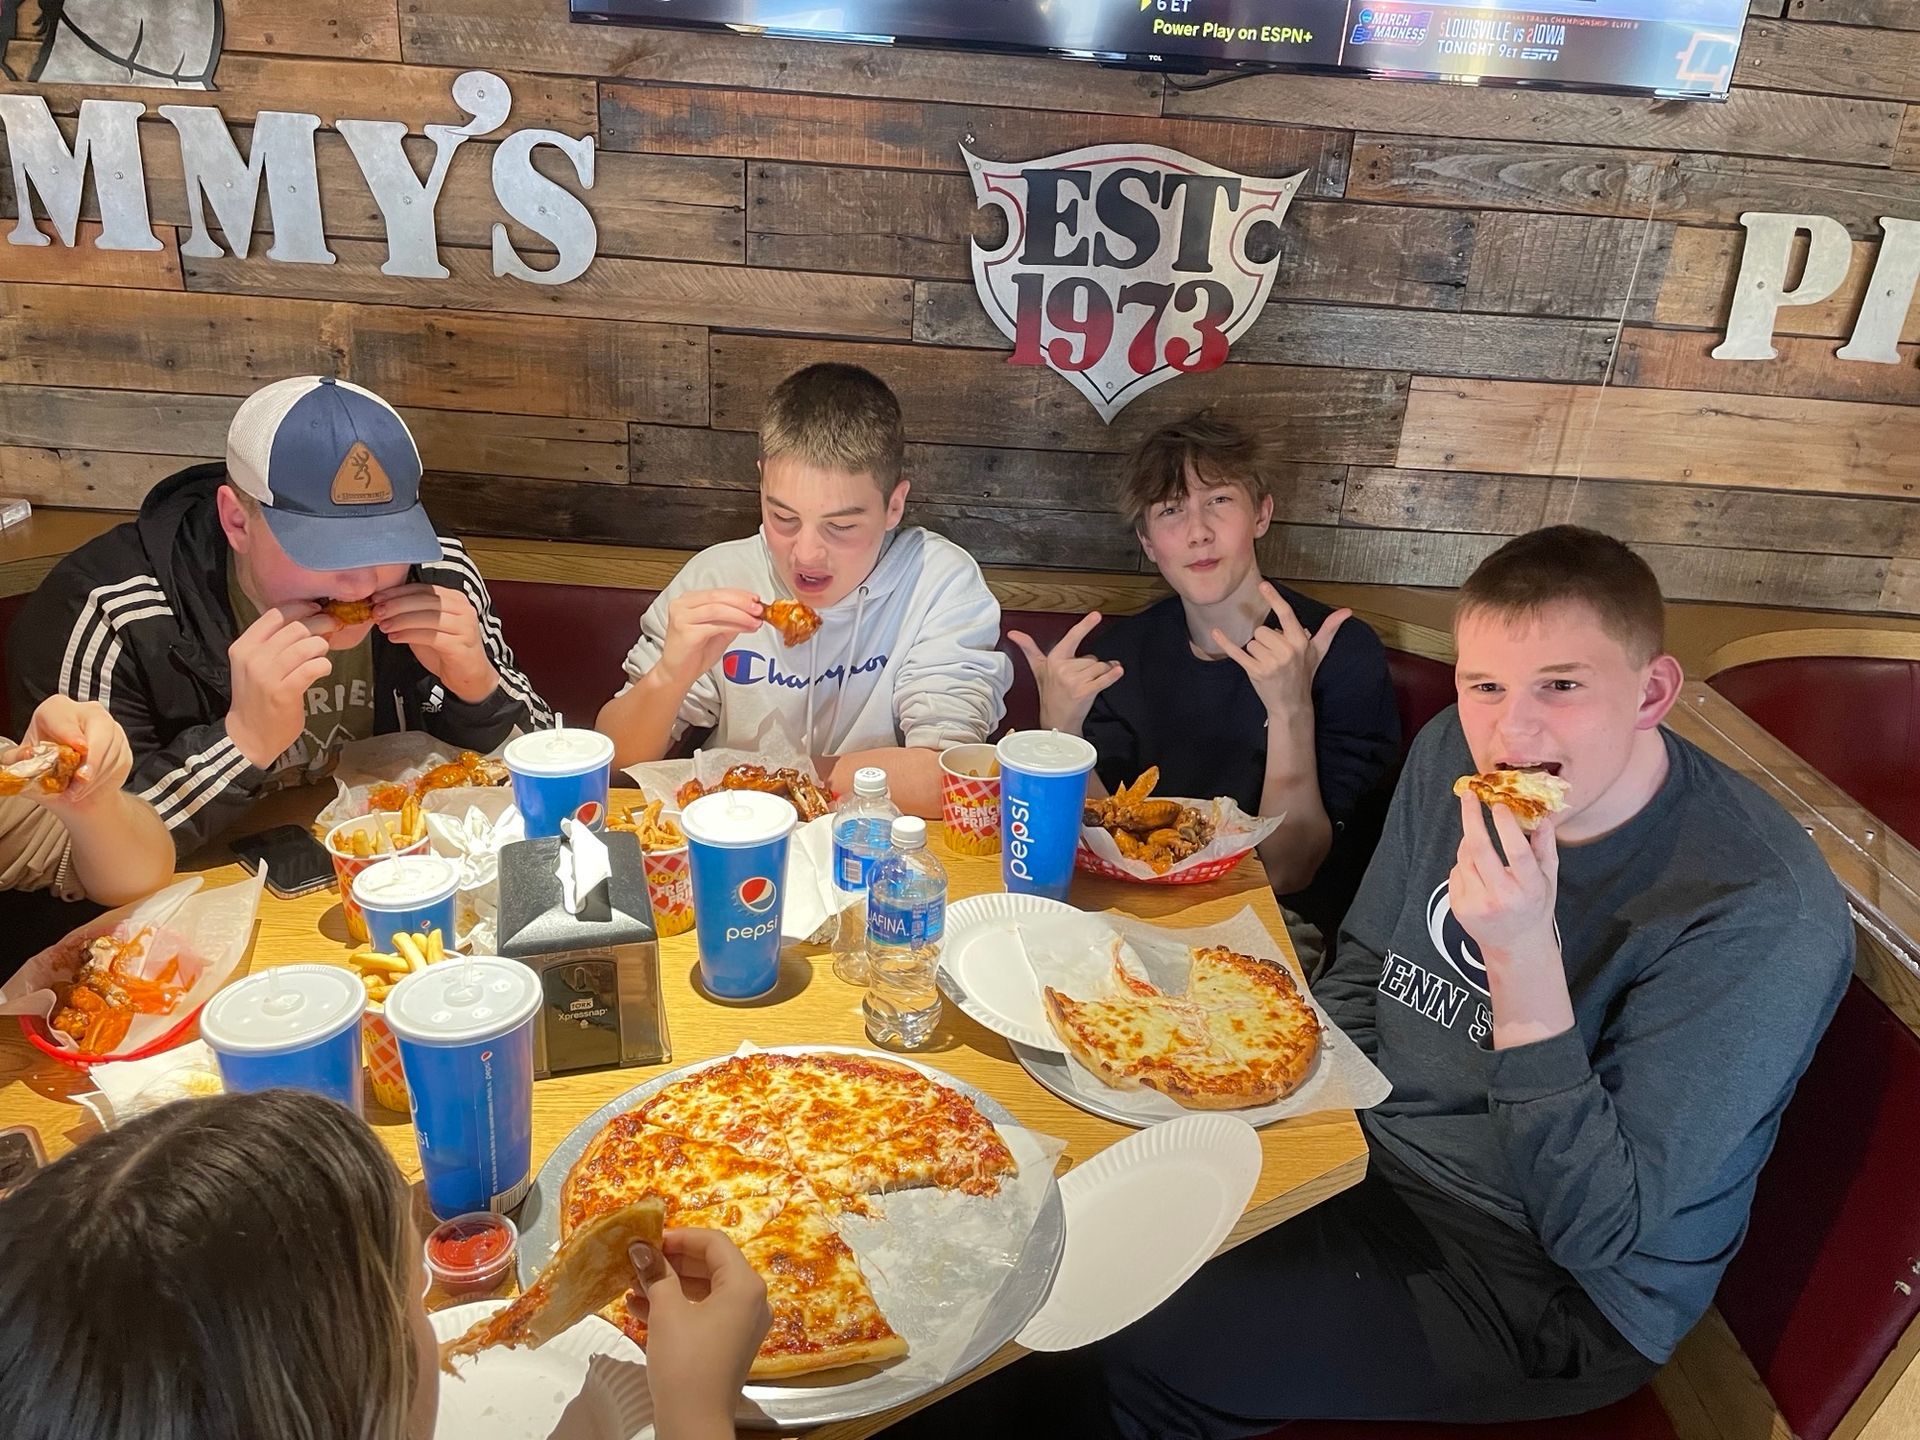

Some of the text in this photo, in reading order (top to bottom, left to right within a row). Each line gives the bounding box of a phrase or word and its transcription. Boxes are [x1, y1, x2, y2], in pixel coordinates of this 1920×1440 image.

[1171, 0, 1192, 13] ET
[1371, 11, 1412, 26] MARCH
[1153, 18, 1313, 44] Power Play on ESPN+
[1373, 25, 1427, 41] MADNESS
[1149, 54, 1163, 62] TCL
[1437, 39, 1495, 57] TONIGHT
[1520, 47, 1560, 62] ESPN
[1018, 167, 1242, 273] EST
[1008, 273, 1235, 374] 1973
[303, 678, 374, 717] RIE
[962, 813, 998, 829] FRIES
[1008, 795, 1035, 880] pepsi
[726, 914, 779, 943] pepsi
[1377, 949, 1470, 1029] ENN
[558, 1008, 607, 1022] Xpressnap
[571, 1001, 592, 1010] TORK
